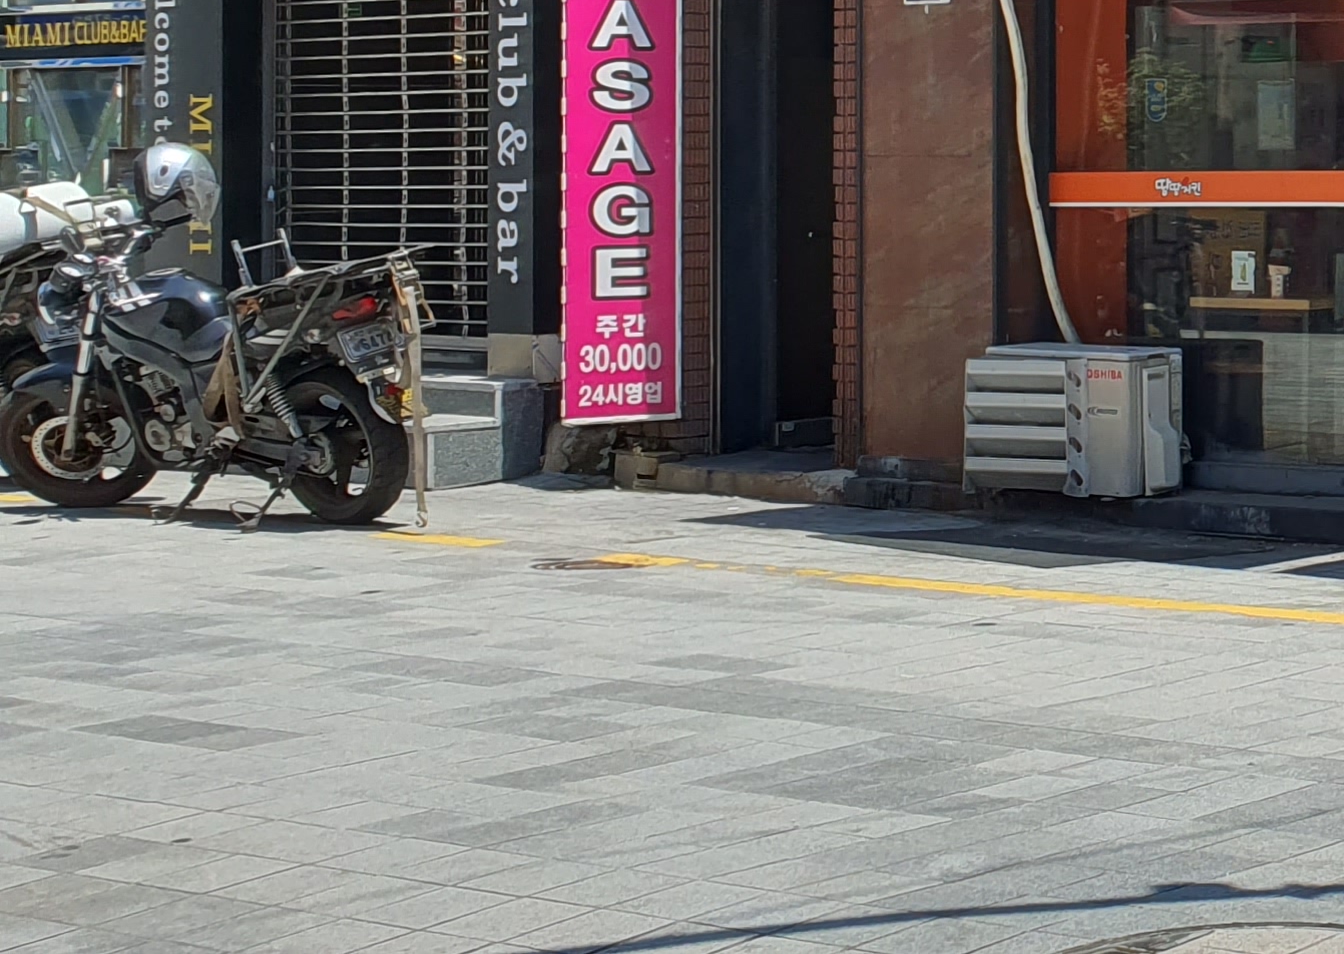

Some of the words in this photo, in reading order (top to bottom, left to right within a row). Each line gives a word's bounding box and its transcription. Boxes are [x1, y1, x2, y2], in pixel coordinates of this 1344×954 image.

[5, 22, 71, 47] MIAMI
[498, 121, 527, 167] &
[497, 178, 528, 284] bar
[579, 342, 662, 374] 30,000
[1087, 368, 1123, 381] OSHIBA
[578, 381, 663, 407] 24시영업
